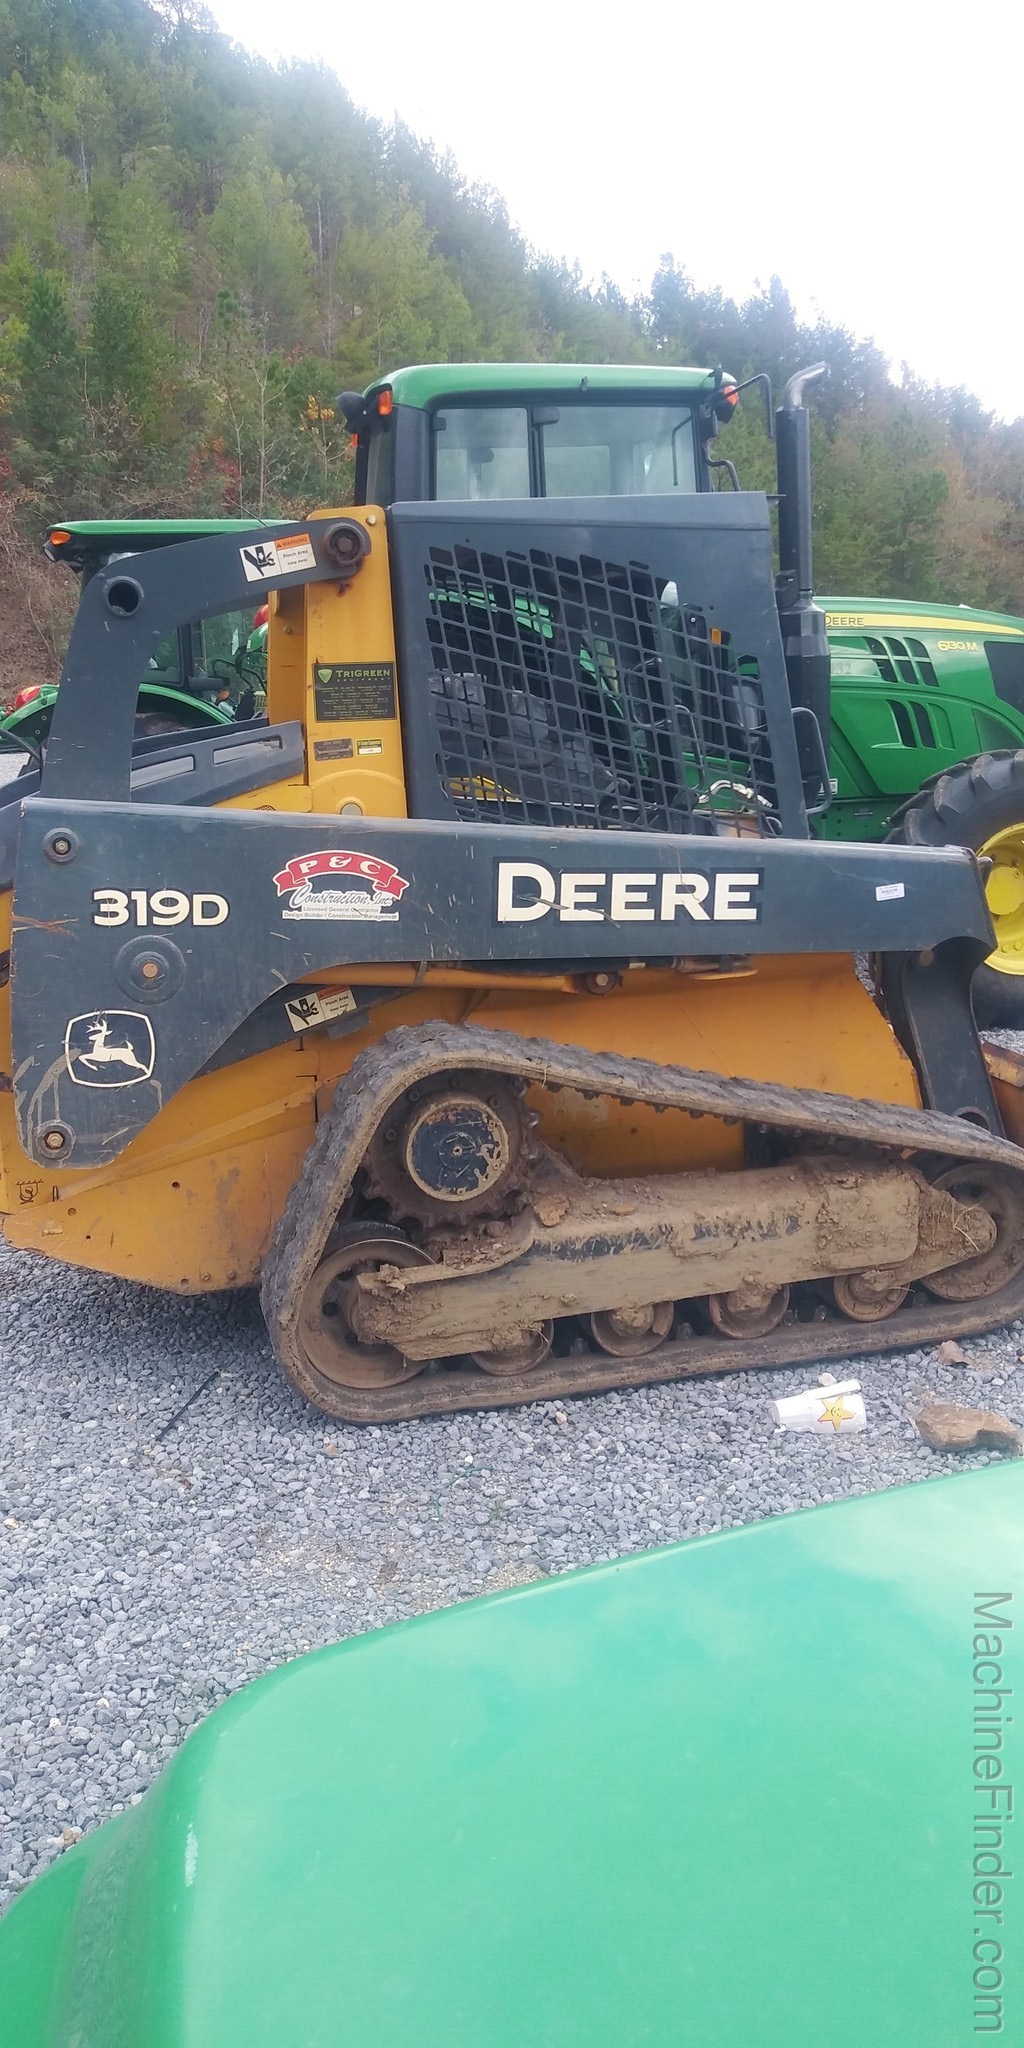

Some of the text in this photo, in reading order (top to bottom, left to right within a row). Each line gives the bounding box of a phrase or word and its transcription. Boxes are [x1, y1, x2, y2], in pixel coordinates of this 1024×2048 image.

[299, 855, 381, 875] P & C
[93, 889, 230, 926] 319D
[497, 862, 760, 922] DEERE
